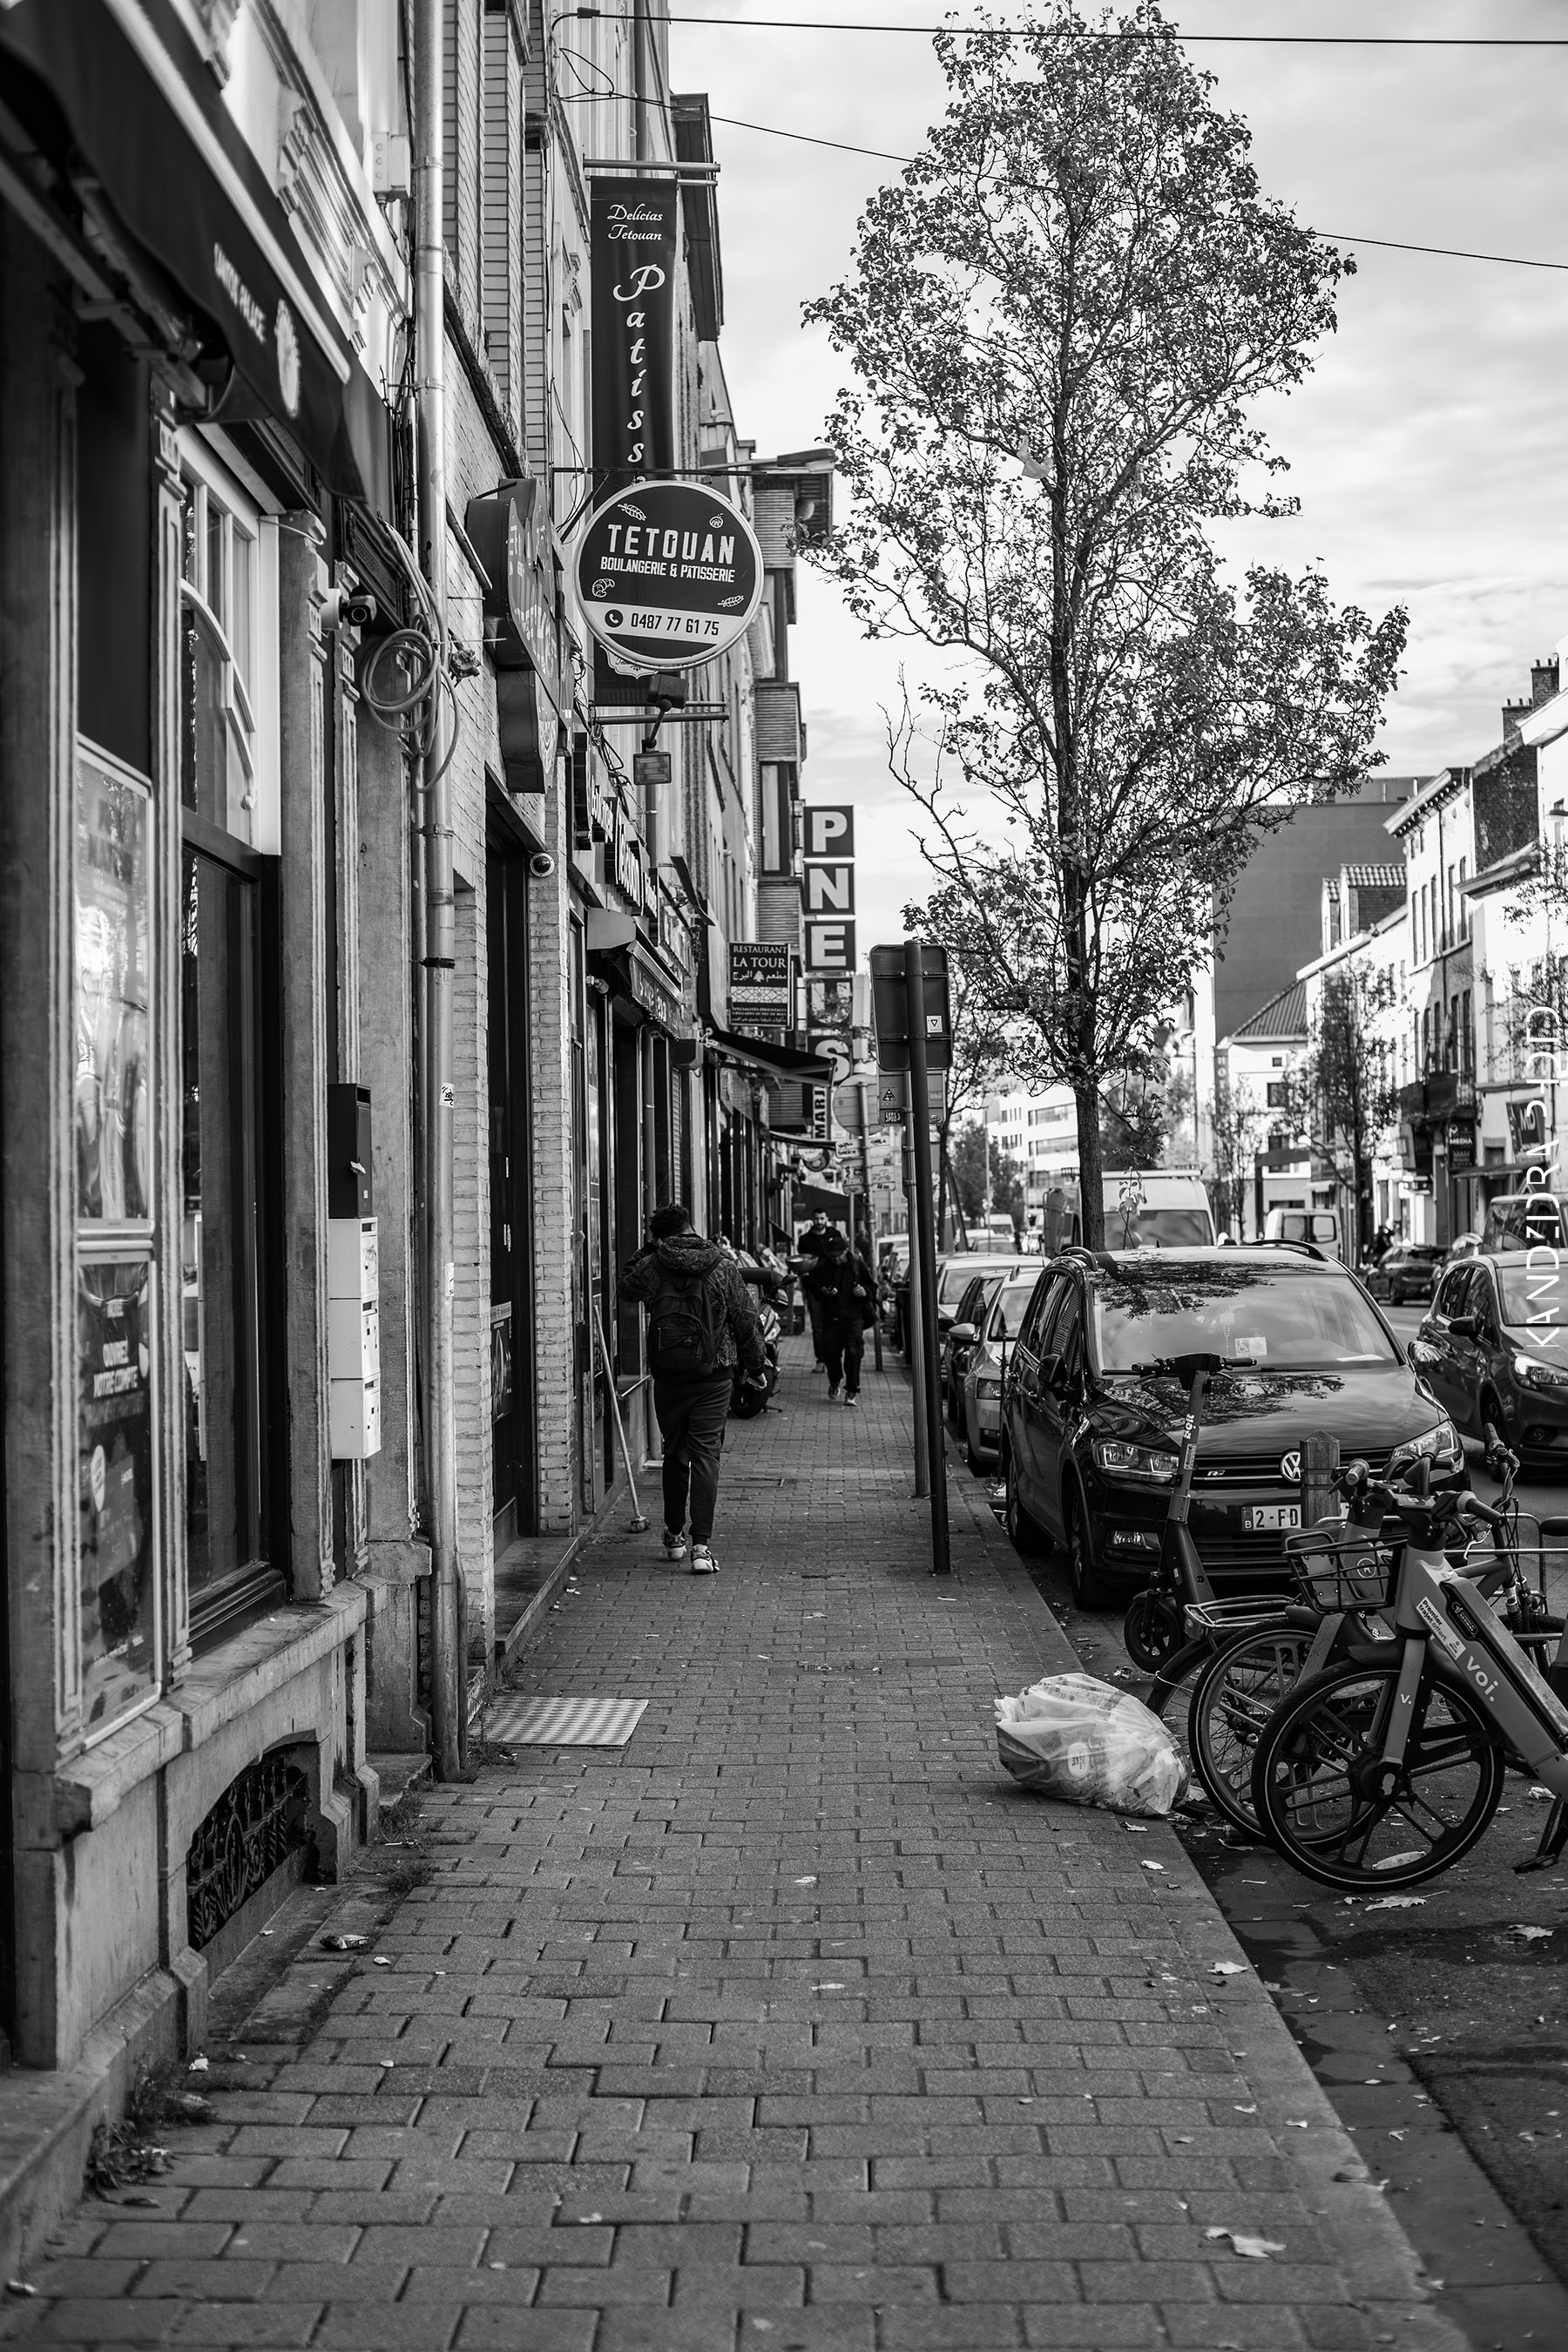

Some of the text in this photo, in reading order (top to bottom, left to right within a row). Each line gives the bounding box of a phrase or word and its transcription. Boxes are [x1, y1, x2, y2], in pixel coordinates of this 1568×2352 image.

[607, 203, 663, 221] Delicias
[607, 224, 662, 240] Tetouan
[608, 524, 735, 564] TETOUAN
[600, 556, 667, 577] BOULANGERIE
[669, 563, 678, 578] &
[631, 612, 720, 637] 0487 77 61 75
[733, 945, 787, 954] RESTAURANT
[733, 956, 787, 968] LA TOUR
[1418, 1605, 1447, 1642] trajet offert
[1423, 1599, 1443, 1626] Premier
